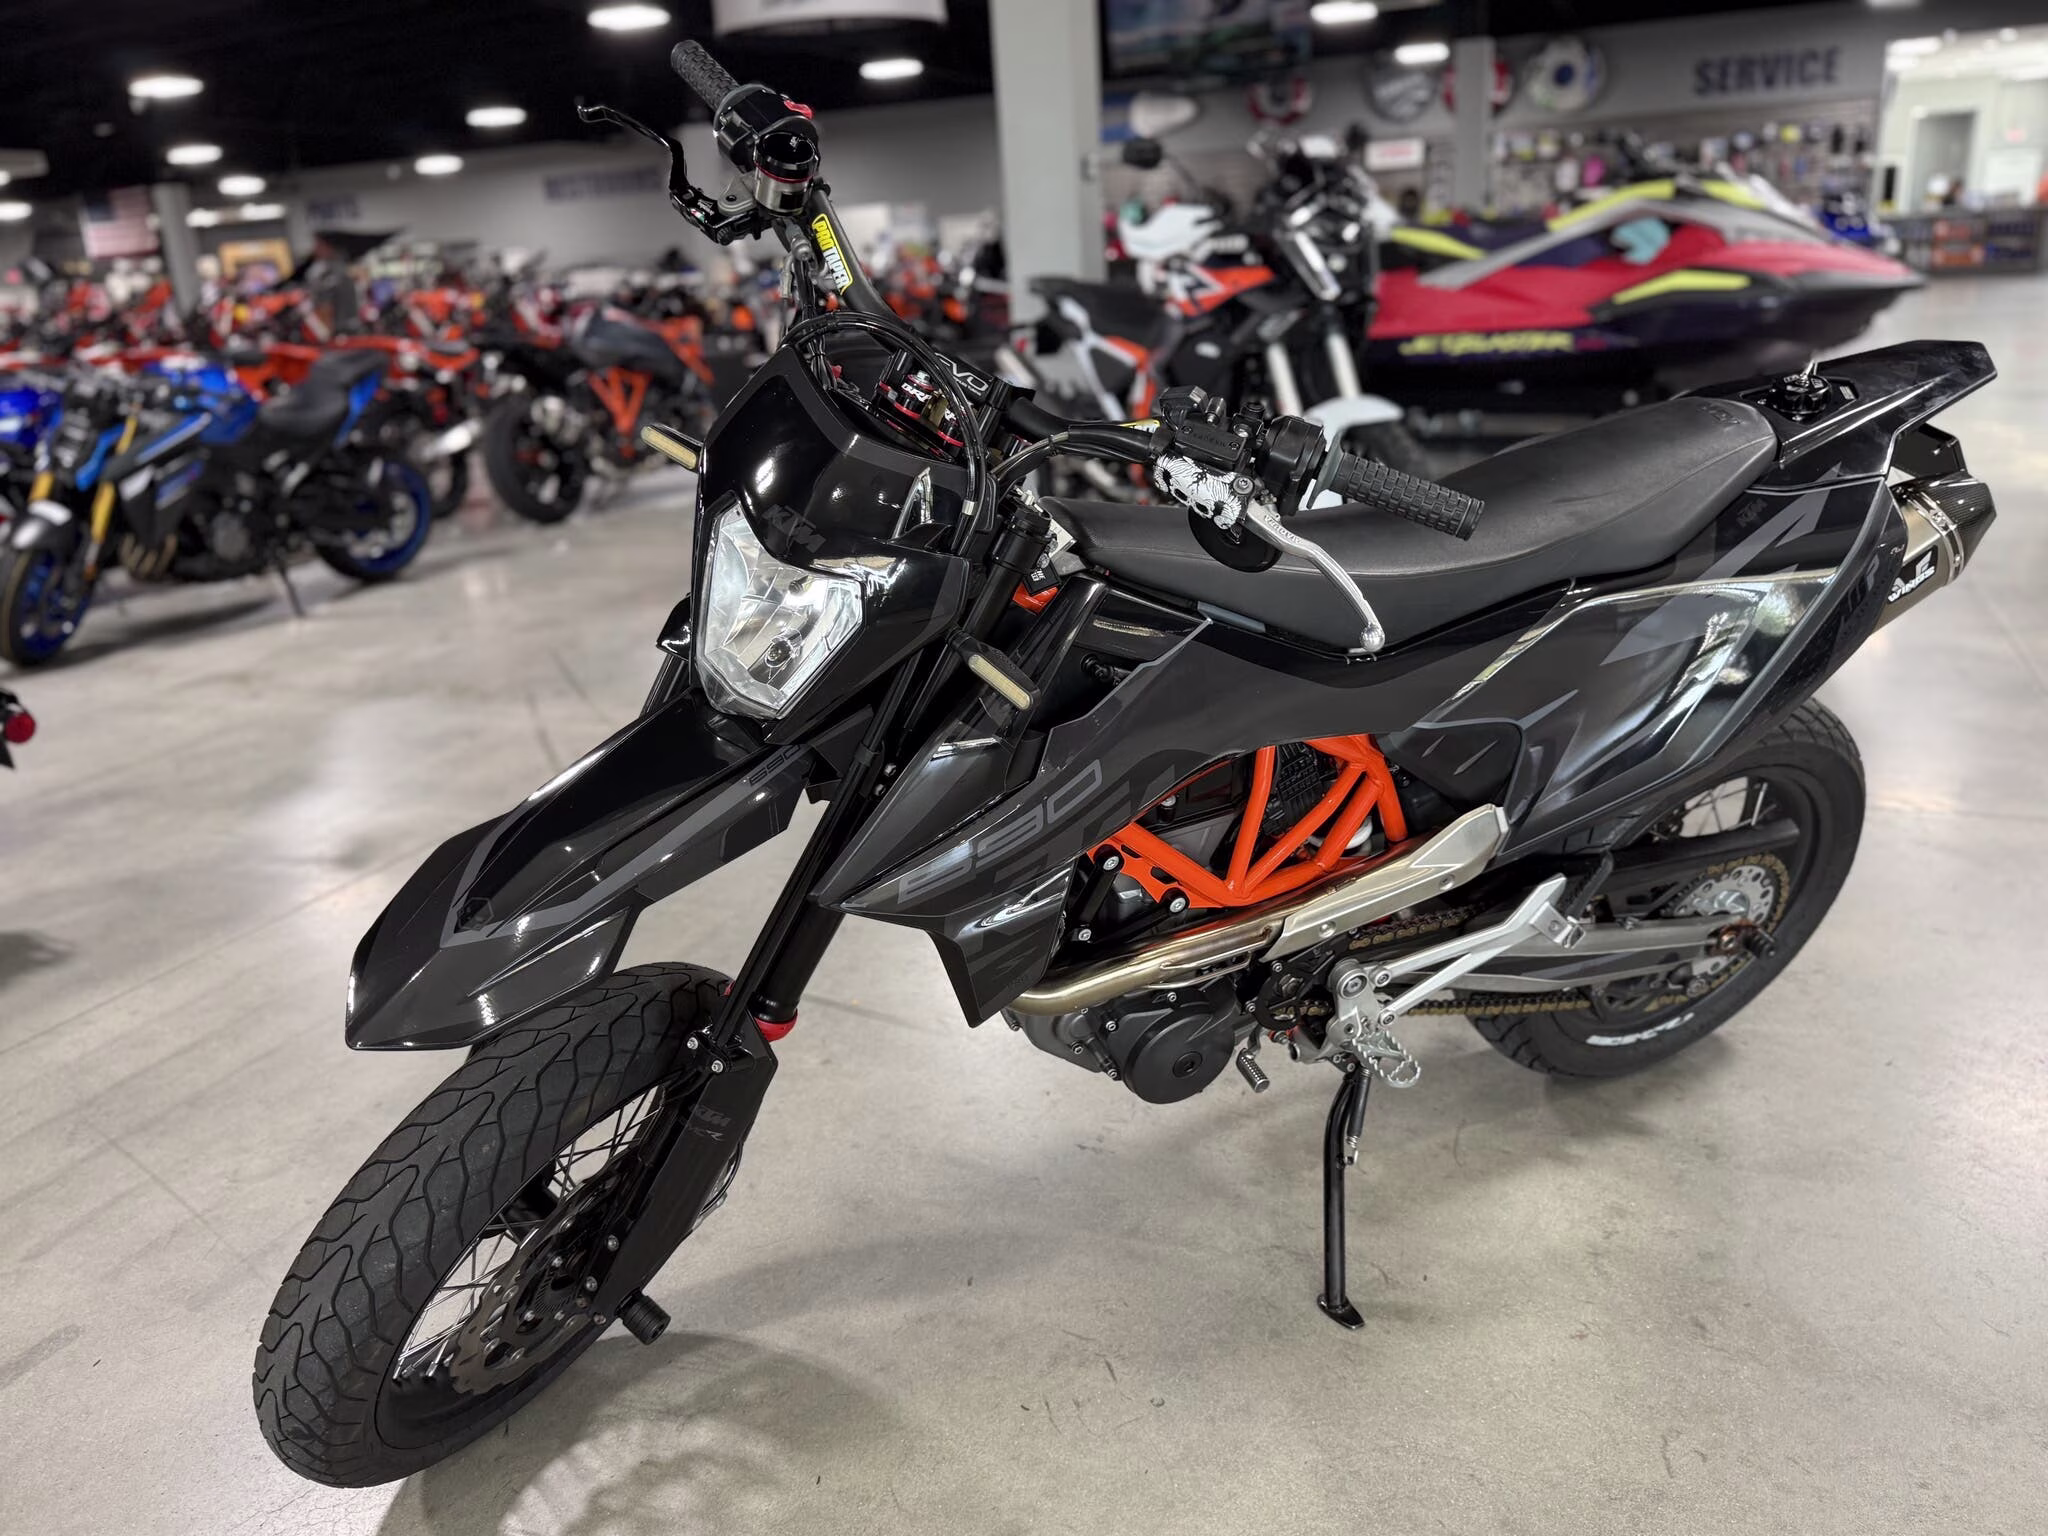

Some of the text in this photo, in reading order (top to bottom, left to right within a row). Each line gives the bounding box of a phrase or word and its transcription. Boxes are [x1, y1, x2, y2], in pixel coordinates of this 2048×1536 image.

[1694, 48, 1840, 96] SERVICE
[1888, 565, 1935, 602] WINGS
[749, 744, 801, 787] 690
[897, 758, 1102, 904] 690
